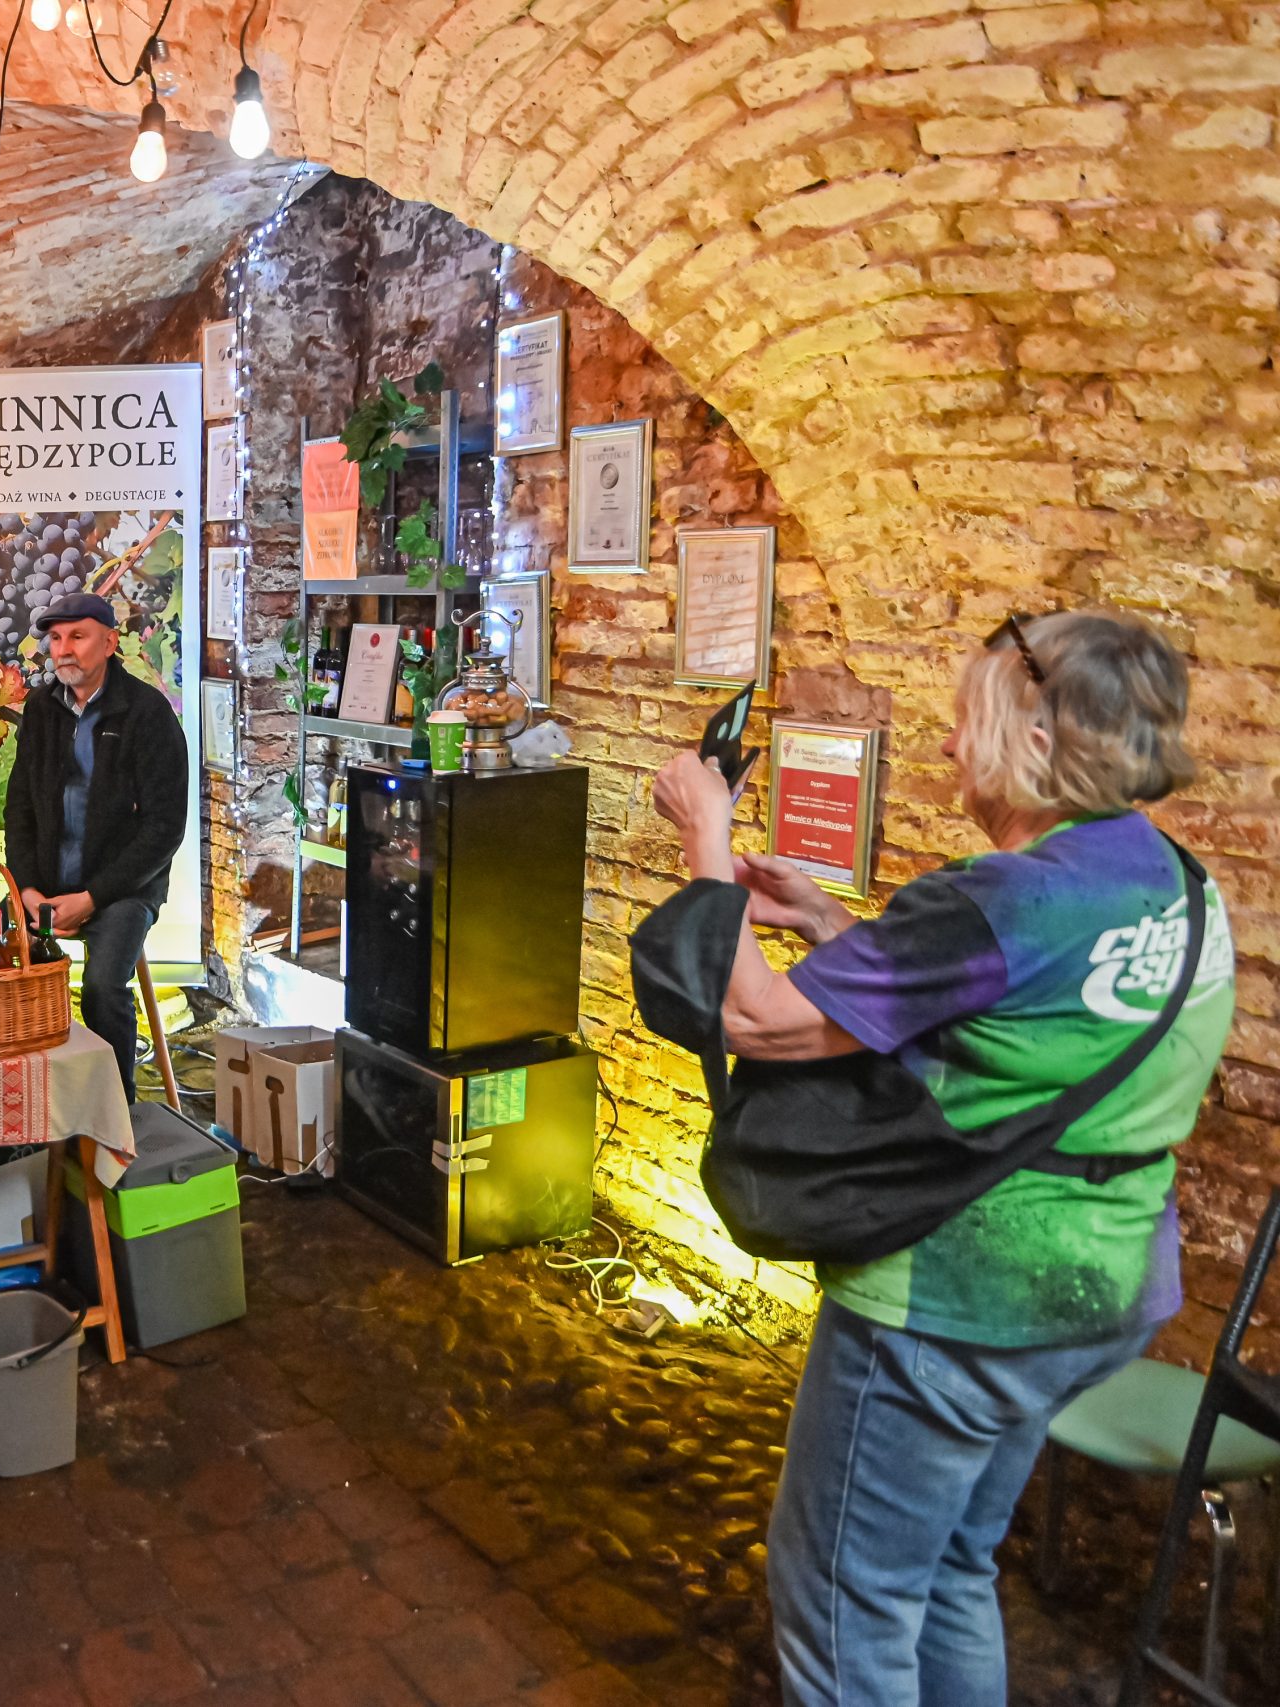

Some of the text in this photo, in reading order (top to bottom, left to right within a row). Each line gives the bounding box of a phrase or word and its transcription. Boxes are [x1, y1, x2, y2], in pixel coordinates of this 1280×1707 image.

[28, 491, 62, 502] WINA
[85, 489, 166, 502] DEGUSTACJE
[702, 574, 745, 584] DYPLOM
